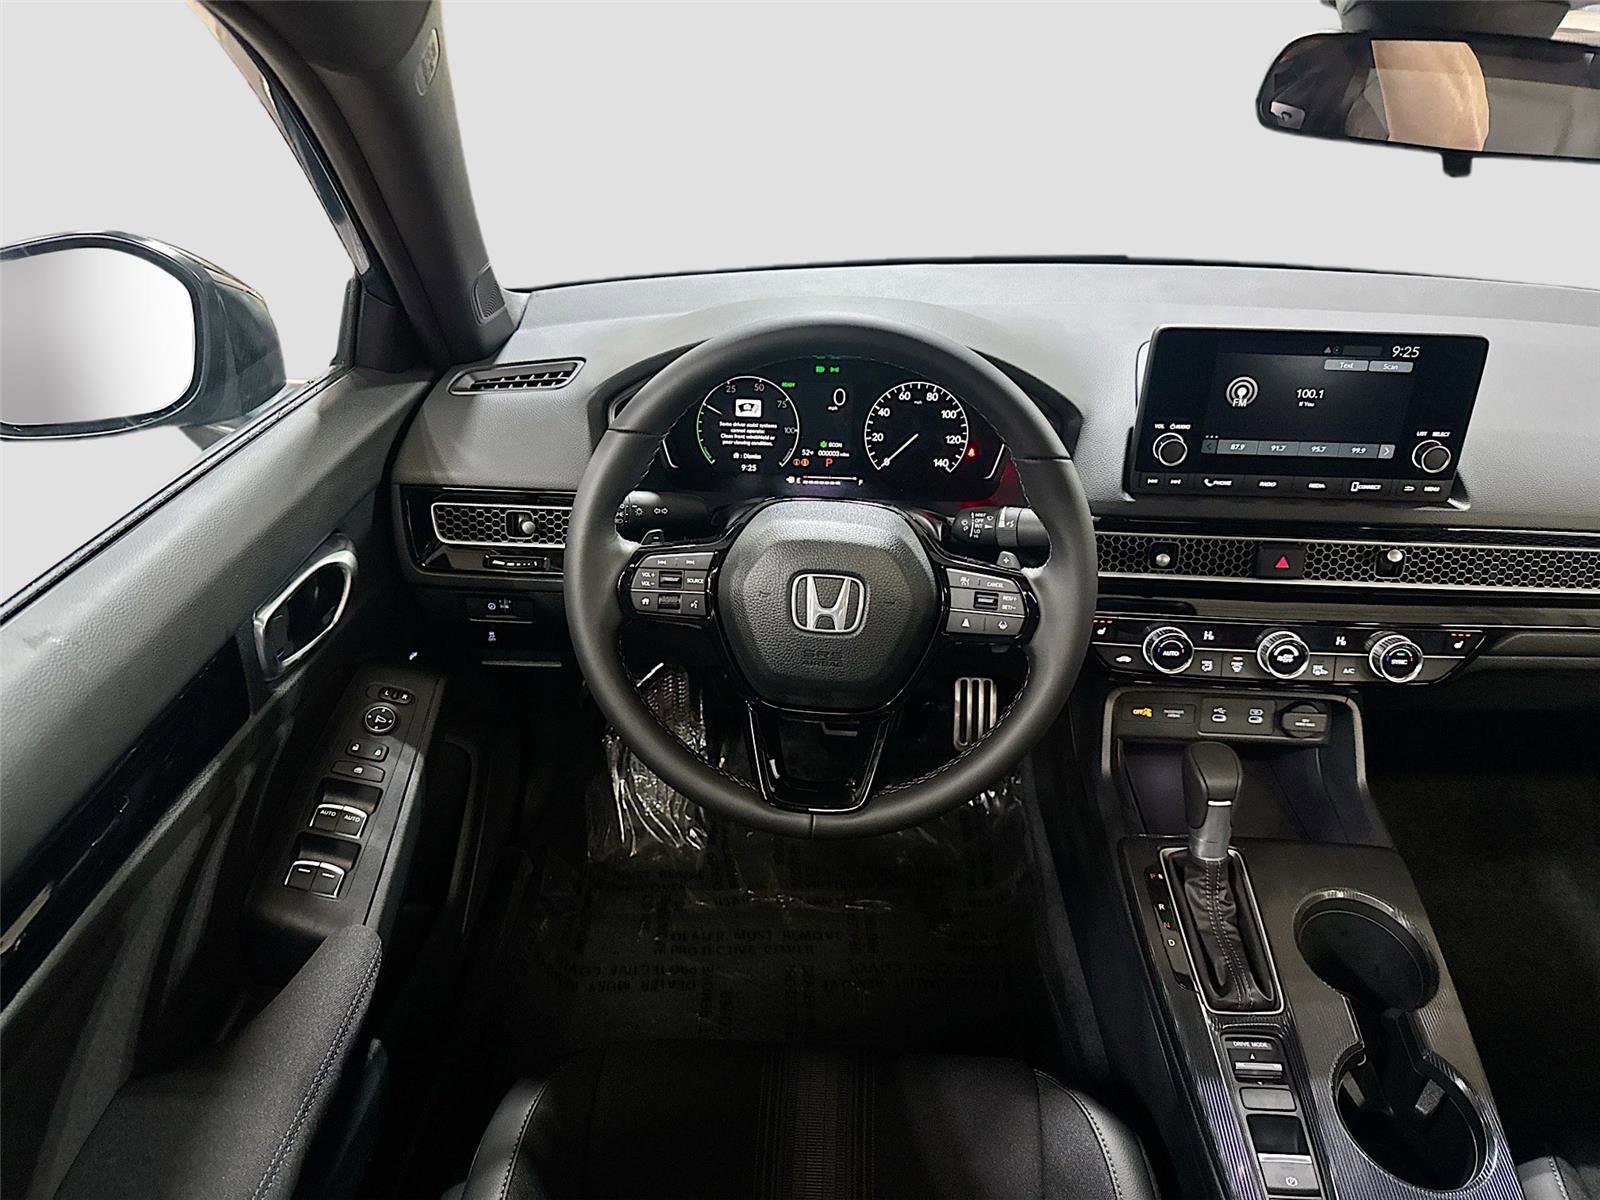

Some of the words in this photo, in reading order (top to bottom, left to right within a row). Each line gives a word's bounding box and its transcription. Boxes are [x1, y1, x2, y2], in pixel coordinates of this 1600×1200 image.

[1392, 346, 1420, 358] 9:25
[726, 385, 736, 393] 25
[754, 384, 765, 392] 50
[833, 388, 846, 406] 0
[898, 392, 911, 401] 60
[926, 392, 939, 402] 80
[1296, 389, 1325, 399] 100.1
[777, 400, 788, 408] 75
[1232, 398, 1248, 407] FM
[878, 408, 890, 417] 40
[941, 410, 957, 419] 100
[872, 433, 884, 441] 20
[945, 435, 961, 444] 120
[825, 458, 833, 467] P
[883, 457, 890, 467] 0
[933, 459, 949, 467] 140
[741, 464, 757, 472] 9:25
[320, 809, 337, 817] AUTO
[343, 814, 361, 823] AUTO
[1158, 903, 1165, 911] R
[1163, 921, 1171, 929] N
[1167, 939, 1176, 947] D
